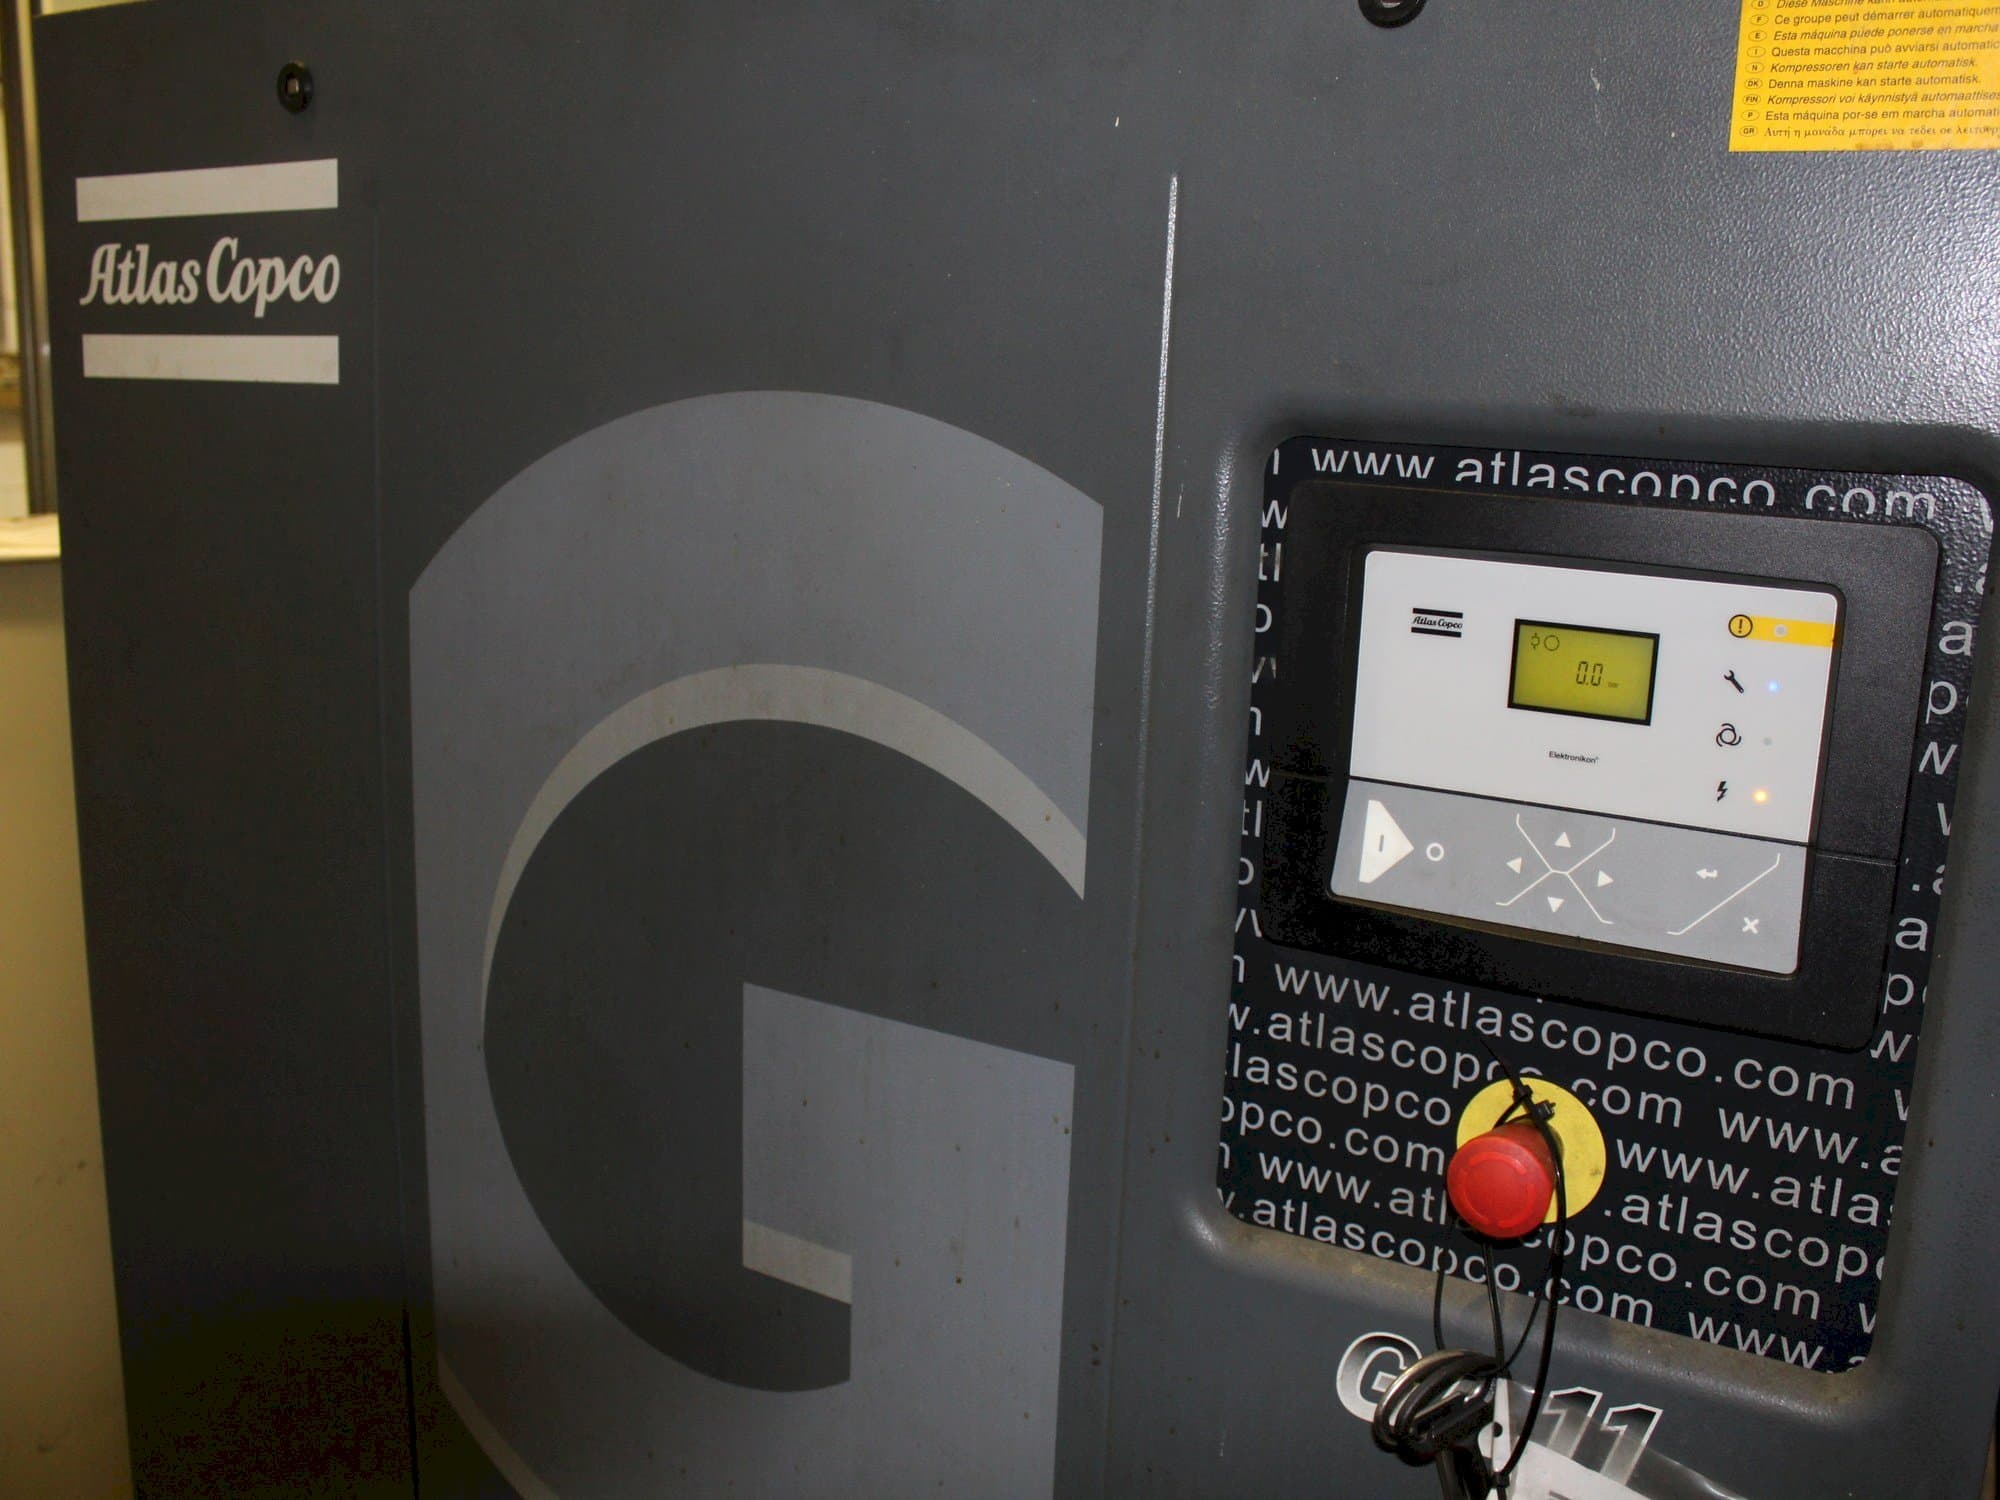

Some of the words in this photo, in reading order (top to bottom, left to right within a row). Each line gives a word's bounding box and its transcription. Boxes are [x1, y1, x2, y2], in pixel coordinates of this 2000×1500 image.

[1774, 15, 1791, 25] Ce
[1794, 14, 1833, 27] groupe
[1835, 12, 1860, 24] peut
[1774, 31, 1798, 41] Esta
[1849, 27, 1885, 39] puede
[1887, 26, 1934, 39] ponerse
[1937, 25, 1952, 34] en
[1772, 46, 1810, 57] Questa
[1814, 44, 1867, 55] macchina
[1895, 42, 1939, 53] avviarsi
[1770, 63, 1850, 73] Kompressoren
[1854, 60, 1874, 71] kan
[1877, 60, 1909, 70] starte
[1769, 79, 1804, 89] Denna
[1807, 77, 1853, 88] maskine
[1856, 77, 1877, 87] kan
[1880, 76, 1912, 87] starte
[1767, 94, 1836, 106] Kompressori
[1766, 110, 1790, 121] Esta
[1792, 109, 1840, 122] máquina
[1842, 110, 1878, 122] por-se
[1881, 110, 1900, 119] em
[1902, 108, 1946, 119] marcha
[80, 243, 201, 306] Atlas
[206, 236, 341, 318] Copco
[1412, 615, 1437, 626] Atlas
[1438, 618, 1463, 629] Copco
[1576, 661, 1604, 687] 0.0
[1275, 964, 1855, 1110] www.atlascopco.com
[1616, 1138, 1894, 1227] www.atla
